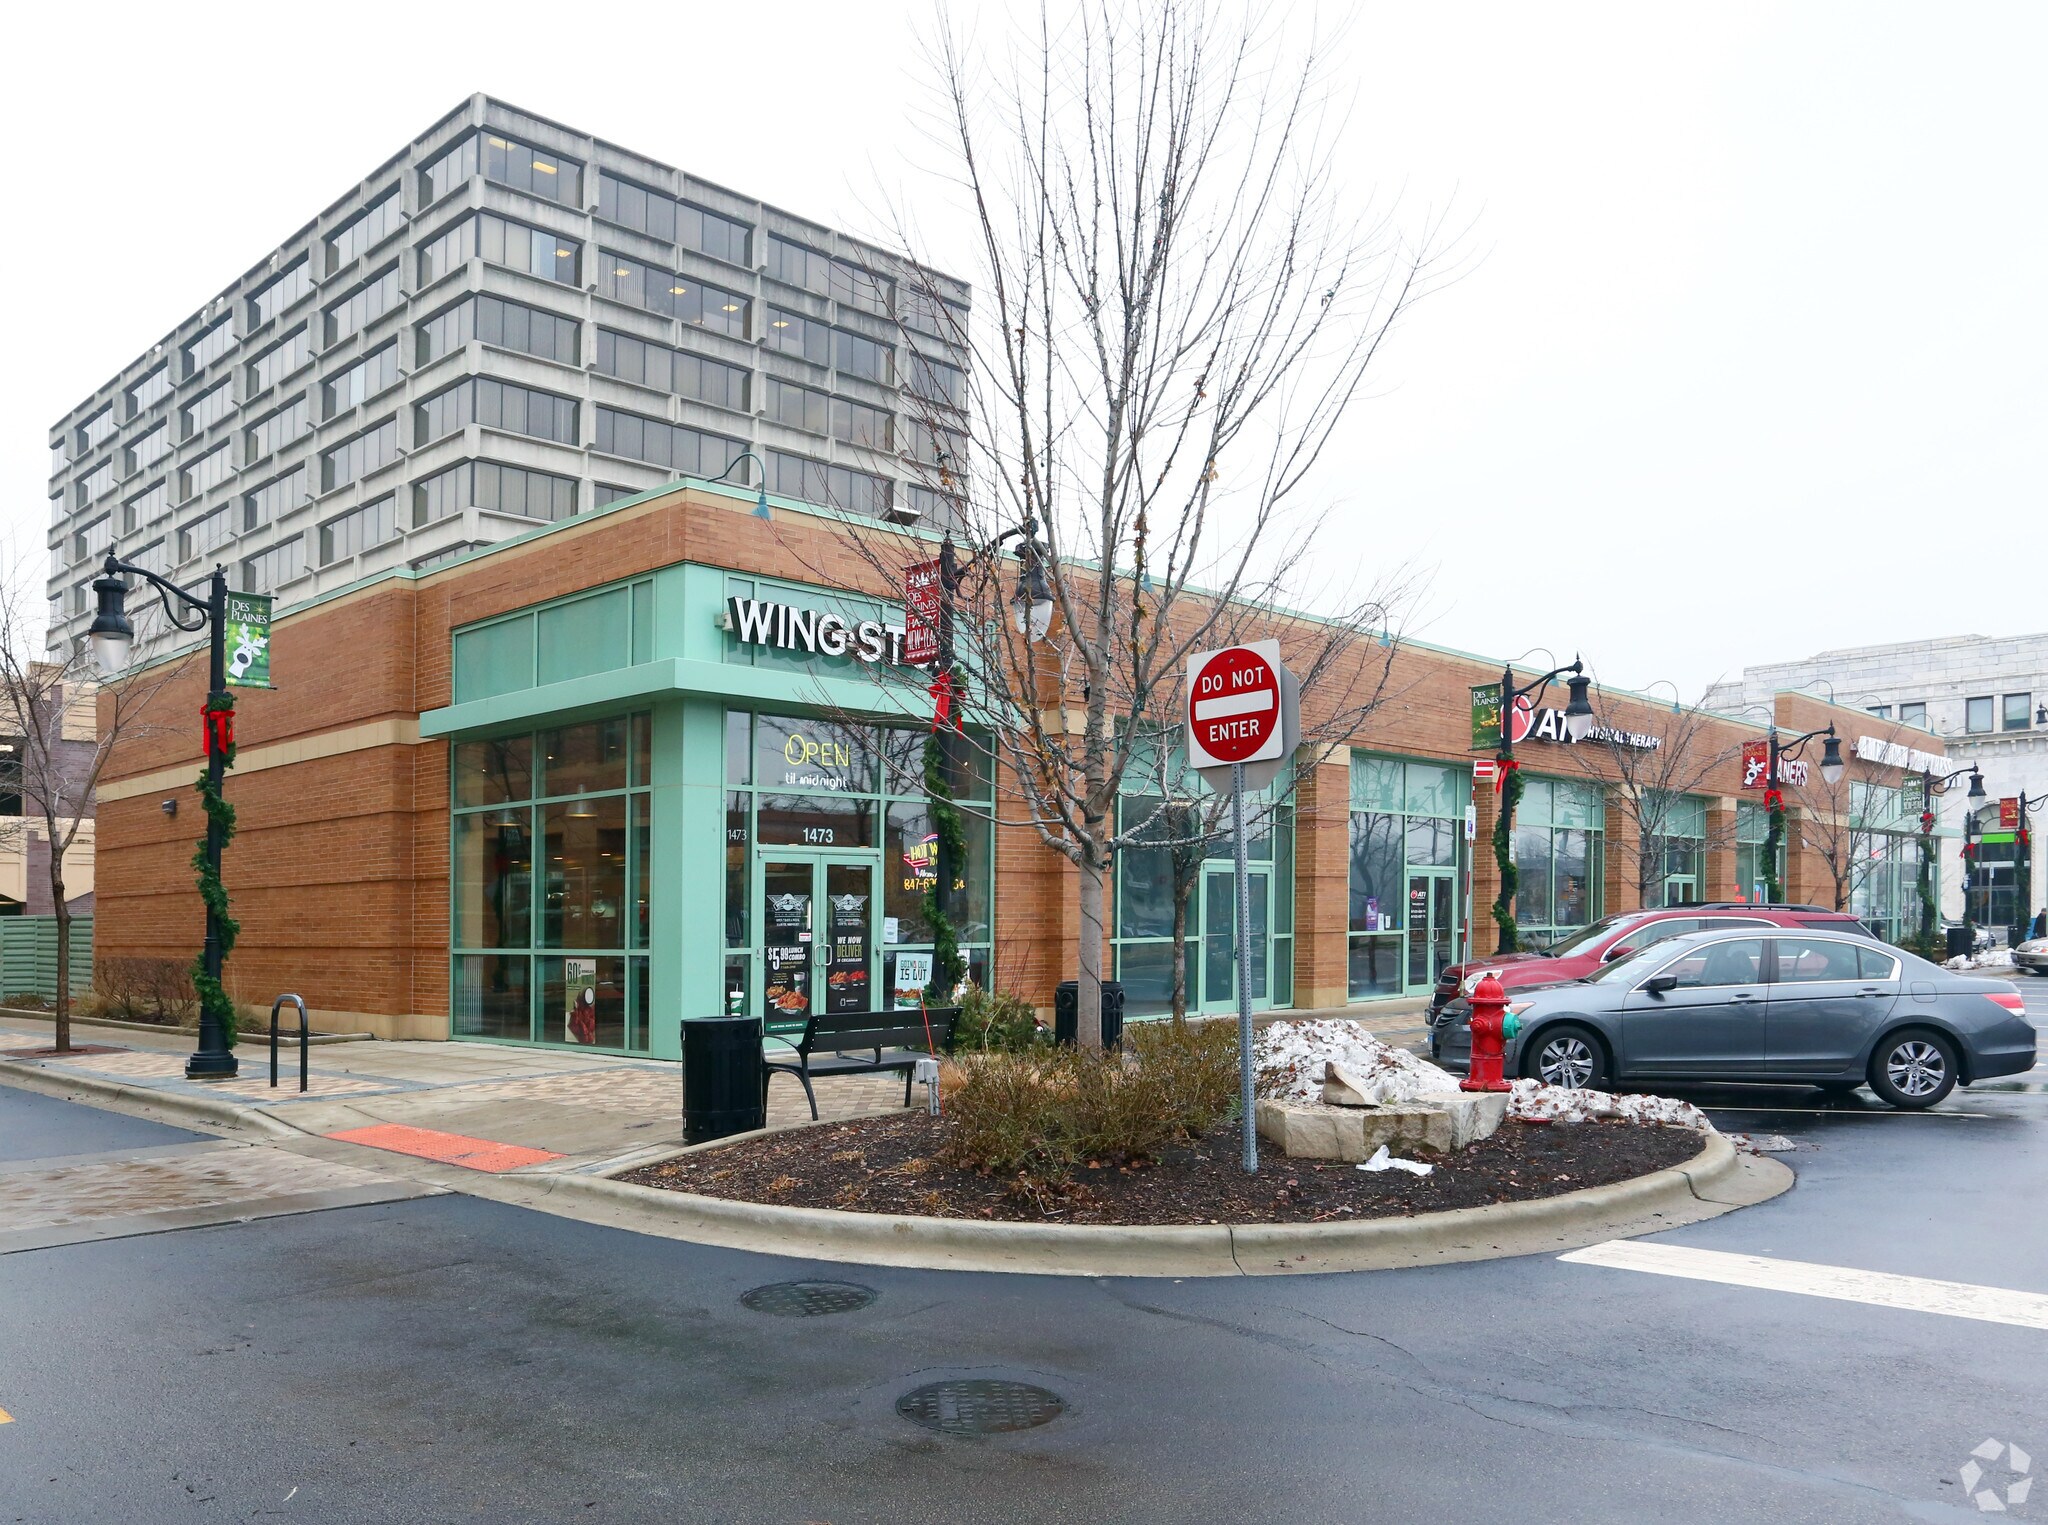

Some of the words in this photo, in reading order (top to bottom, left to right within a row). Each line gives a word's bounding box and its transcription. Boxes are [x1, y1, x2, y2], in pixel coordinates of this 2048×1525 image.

[231, 600, 250, 612] DES
[231, 609, 268, 625] PLAINES
[1202, 674, 1223, 694] DO
[1232, 666, 1265, 688] NOT
[1473, 691, 1486, 699] DES
[1473, 696, 1499, 706] PLAINES
[1209, 719, 1260, 742] ENTER
[784, 734, 849, 767] OPEN
[785, 772, 796, 785] til
[727, 829, 747, 840] 1473
[803, 827, 834, 843] 1473
[910, 843, 928, 861] HOT
[837, 936, 846, 945] WE
[847, 936, 863, 945] NOW
[789, 946, 804, 954] LUNCH
[837, 944, 863, 958] DELIVER
[789, 953, 806, 961] COMBO
[900, 968, 910, 981] IS
